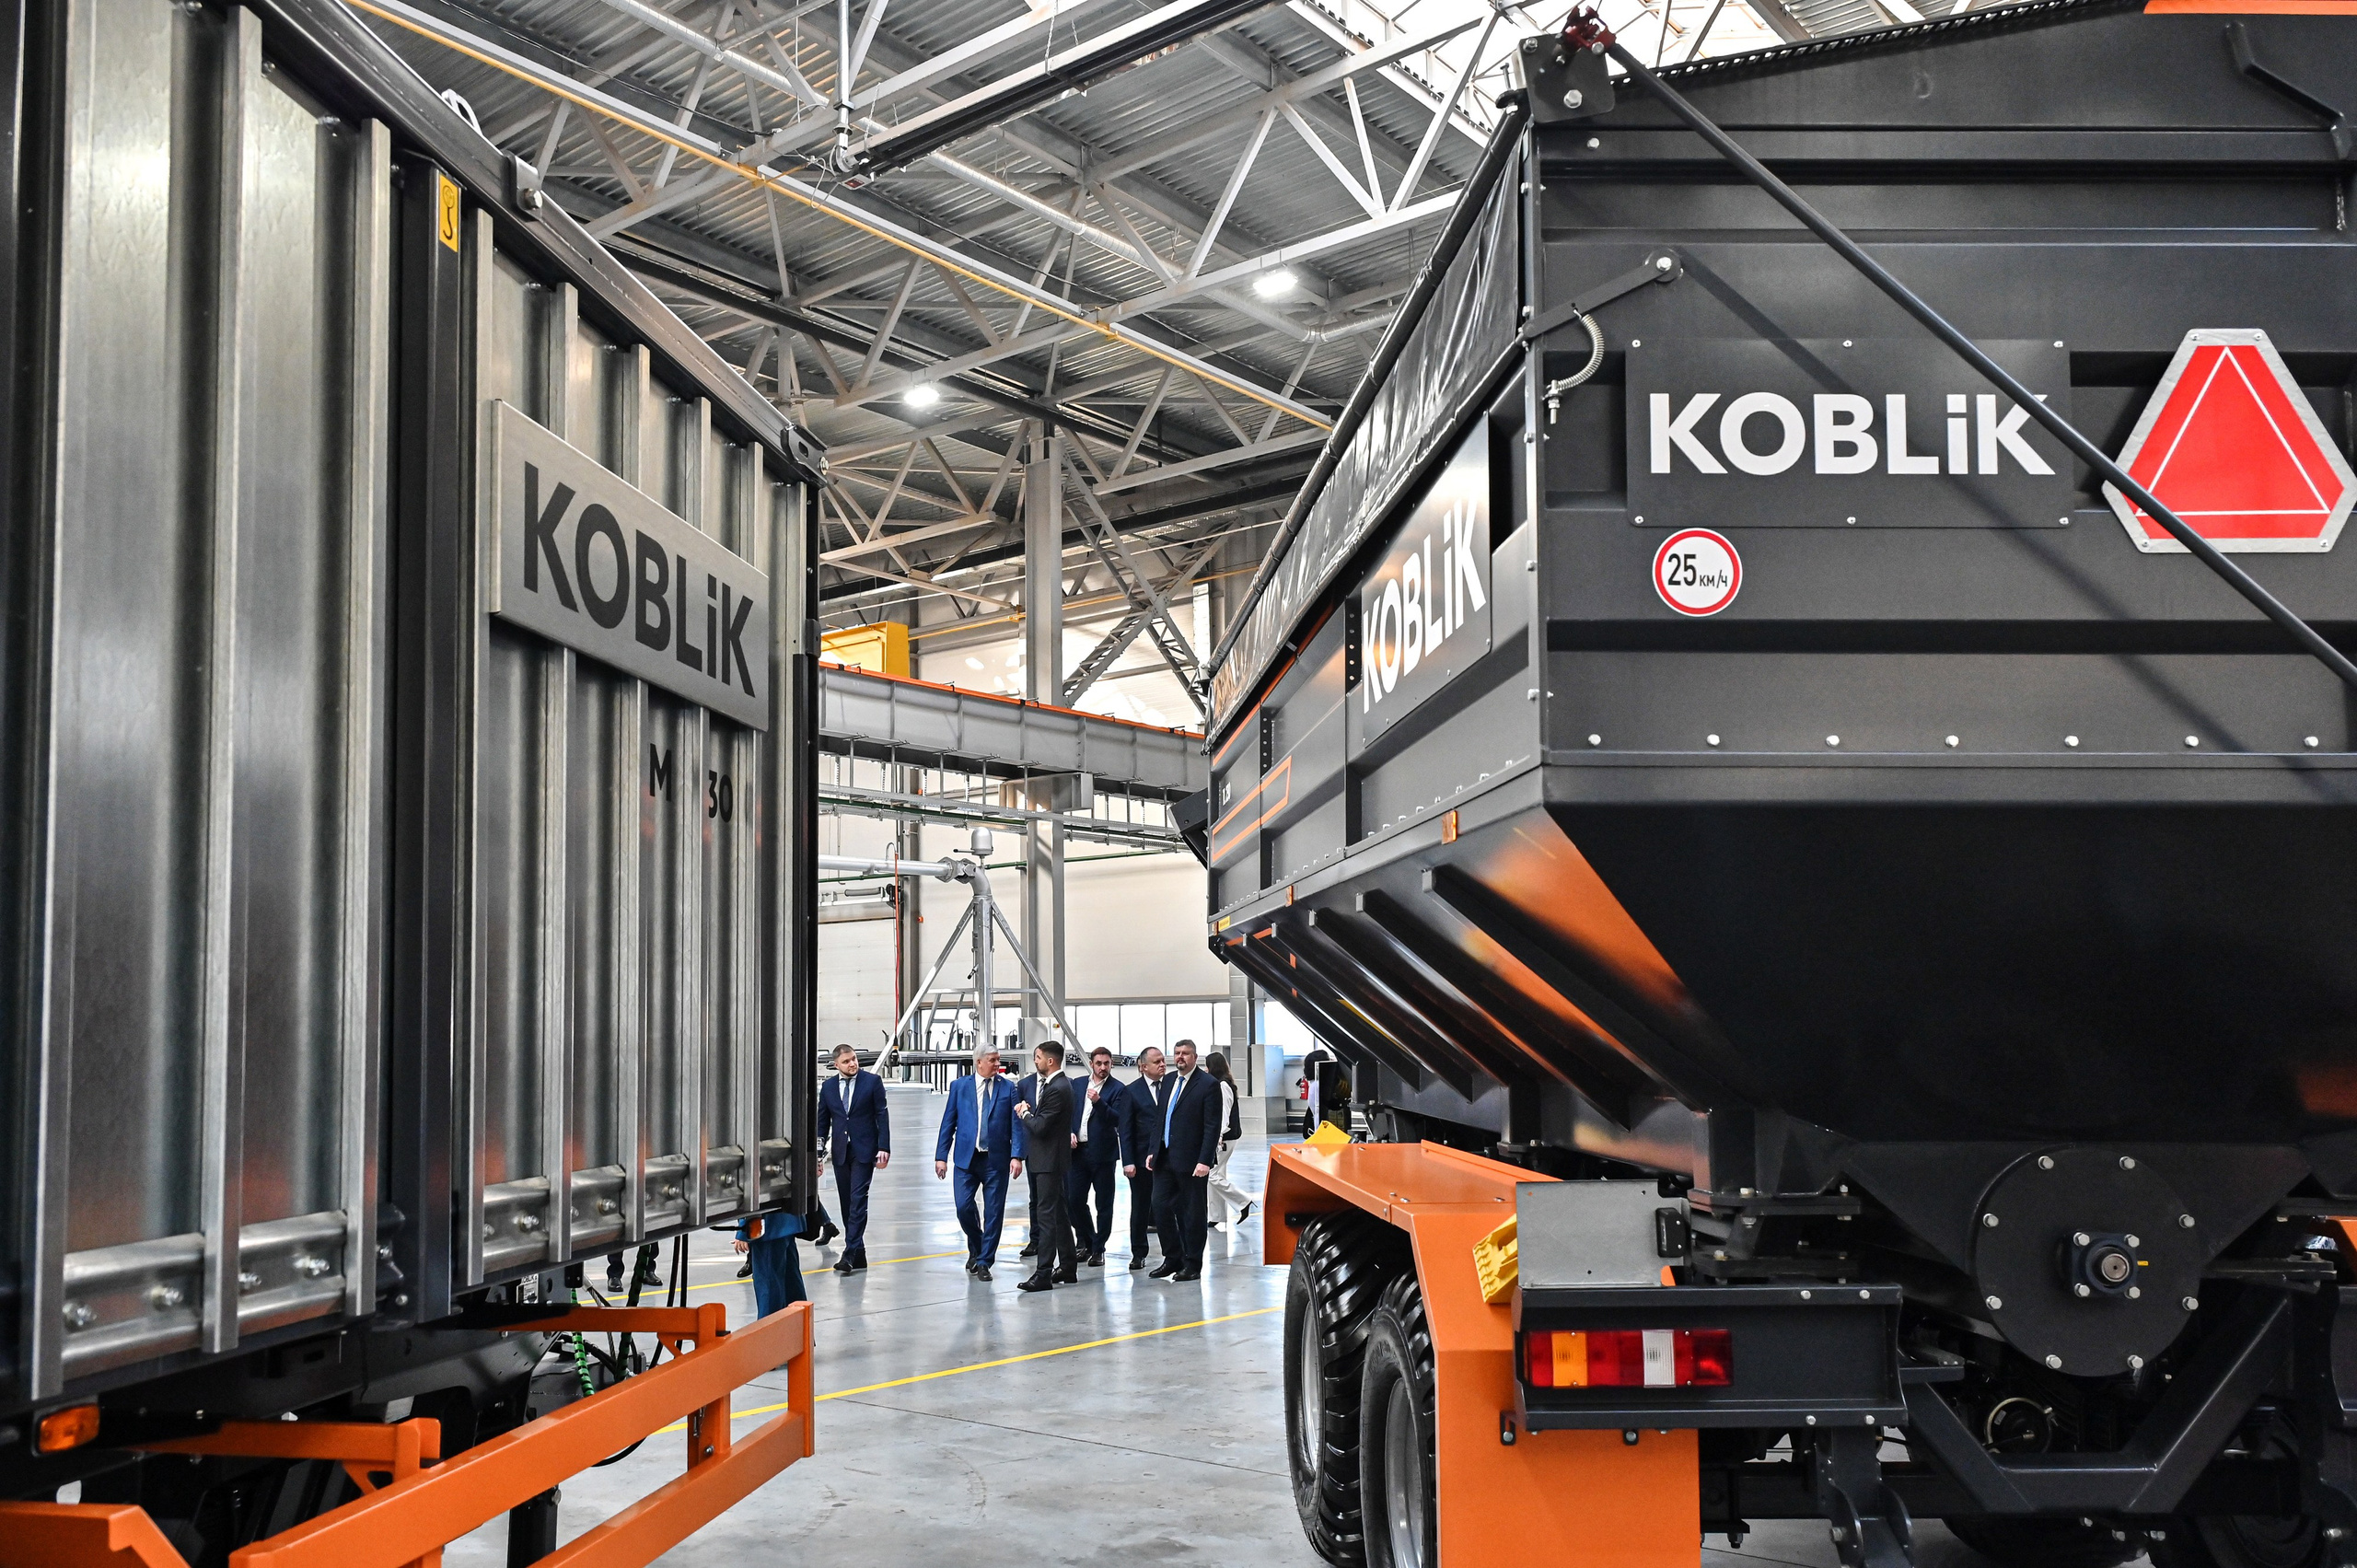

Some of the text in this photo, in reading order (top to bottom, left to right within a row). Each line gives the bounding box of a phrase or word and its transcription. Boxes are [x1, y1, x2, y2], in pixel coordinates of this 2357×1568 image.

[1667, 553, 1697, 587] 25
[649, 742, 734, 823] M 30
